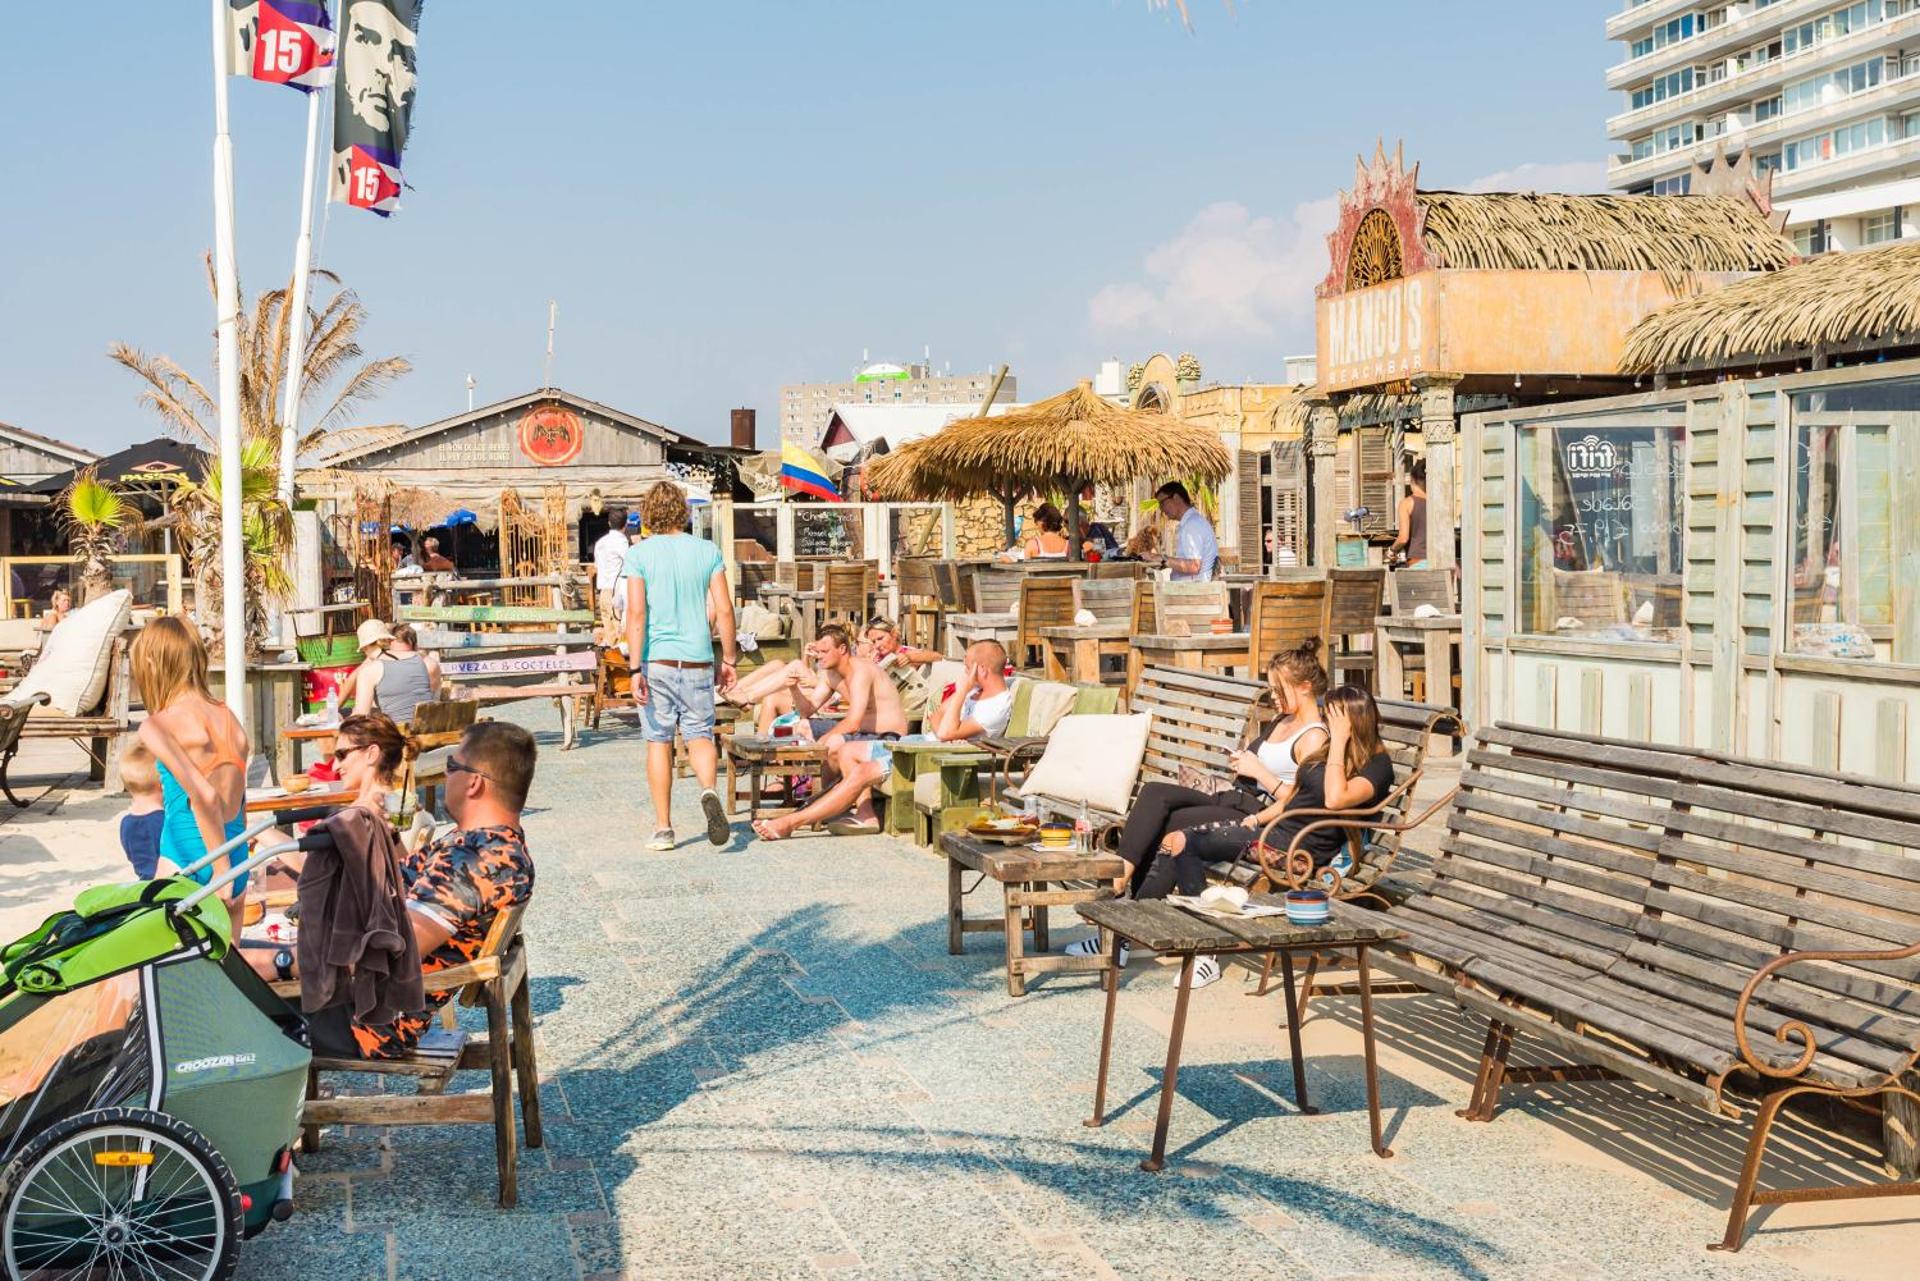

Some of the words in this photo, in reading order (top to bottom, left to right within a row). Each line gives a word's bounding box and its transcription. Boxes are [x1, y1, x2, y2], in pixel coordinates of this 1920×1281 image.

[261, 29, 302, 73] 15
[354, 166, 381, 201] 15
[1328, 279, 1422, 369] MANGO'S
[1329, 354, 1422, 384] BEACHBAR
[175, 1055, 235, 1074] CROOZER
